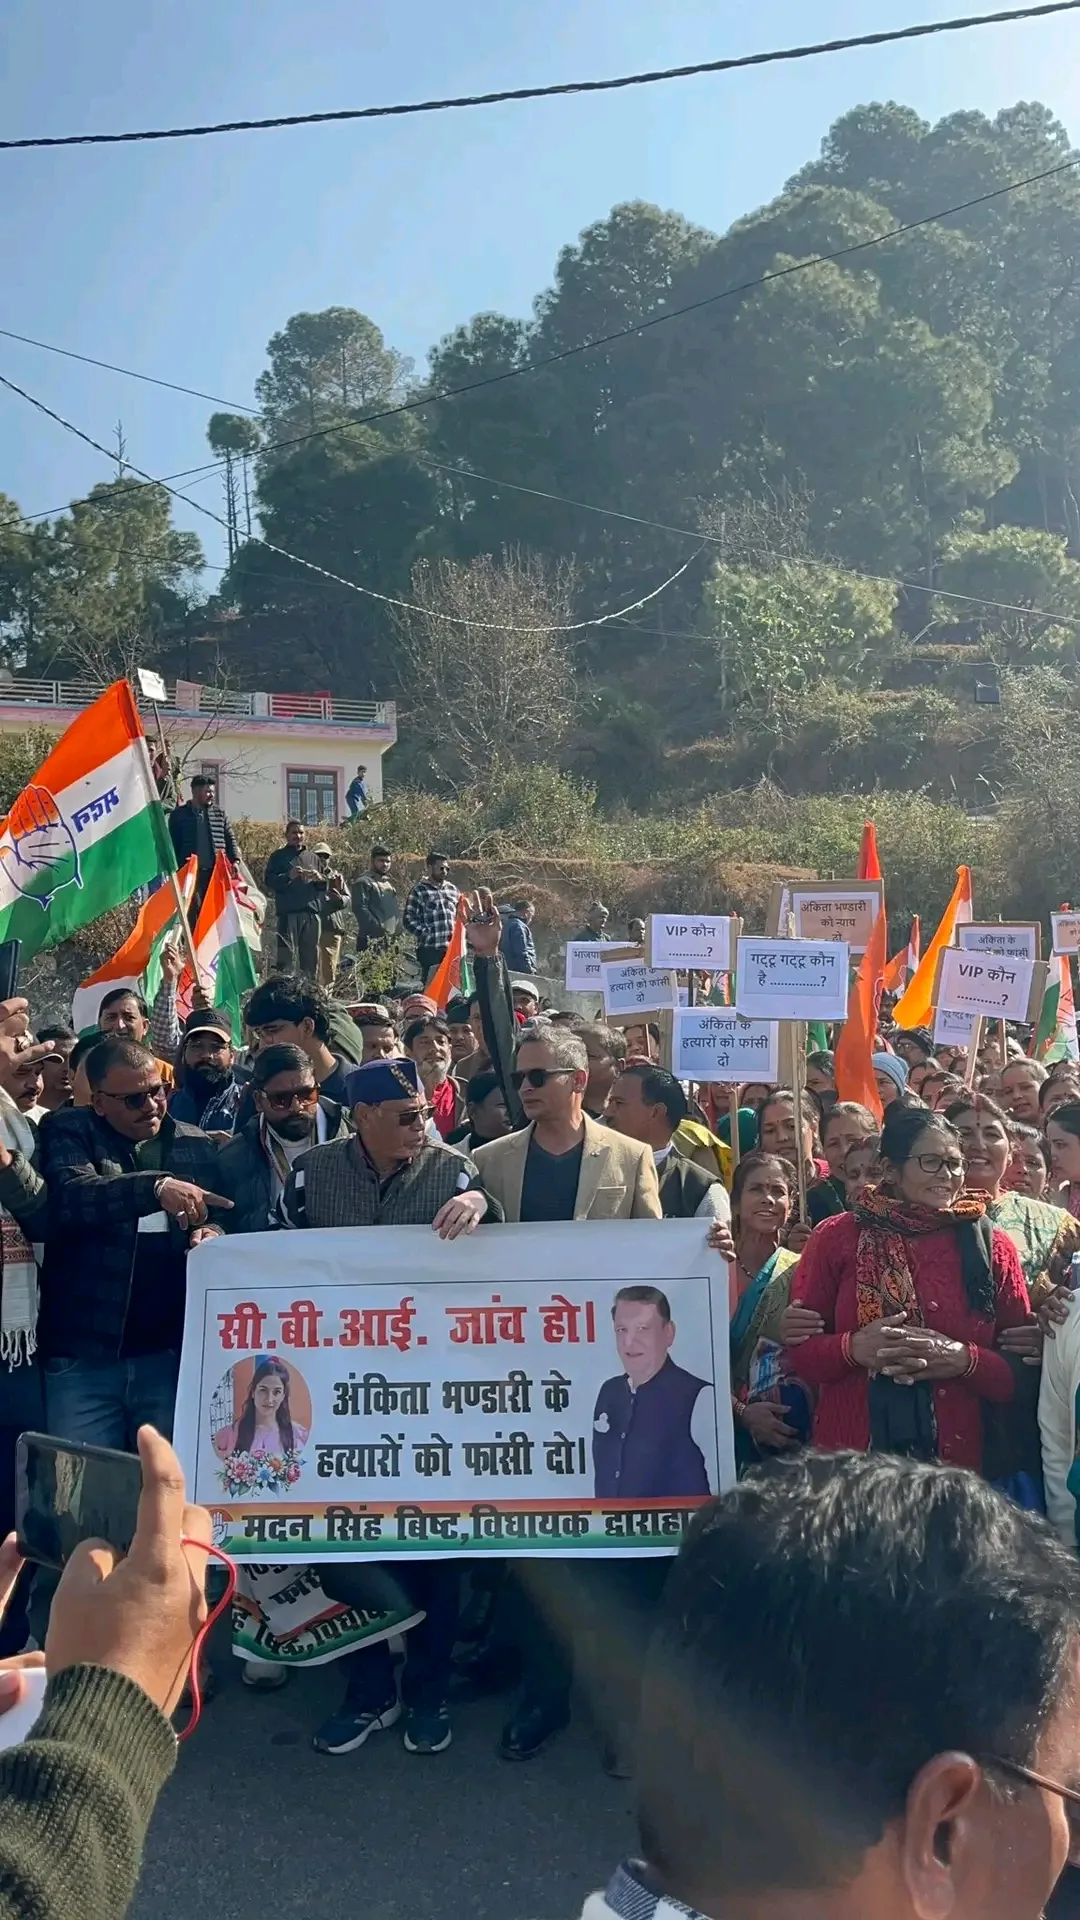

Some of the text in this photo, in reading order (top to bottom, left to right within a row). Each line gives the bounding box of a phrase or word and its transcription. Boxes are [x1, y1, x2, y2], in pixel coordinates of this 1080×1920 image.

[834, 900, 867, 912] भण्डारी
[820, 916, 856, 928] को न्याय
[666, 925, 716, 937] VIP कौन
[810, 951, 835, 967] कौन
[757, 970, 767, 987] है
[958, 964, 1016, 984] VIP कौन
[636, 978, 647, 989] को
[636, 990, 645, 1002] दो
[698, 1017, 737, 1031] अंकिता
[681, 1034, 769, 1050] हत्यारों को फांसी
[717, 1053, 730, 1067] दो
[217, 1295, 595, 1352] सी.बी.आई. जांच हो।
[332, 1370, 572, 1416] अंकिता भण्डारी के
[315, 1432, 585, 1479] हत्यारों को फांसी दो।
[241, 1515, 314, 1542] मदन
[324, 1505, 384, 1542] सिंह
[602, 1508, 696, 1538] द्वाराहा
